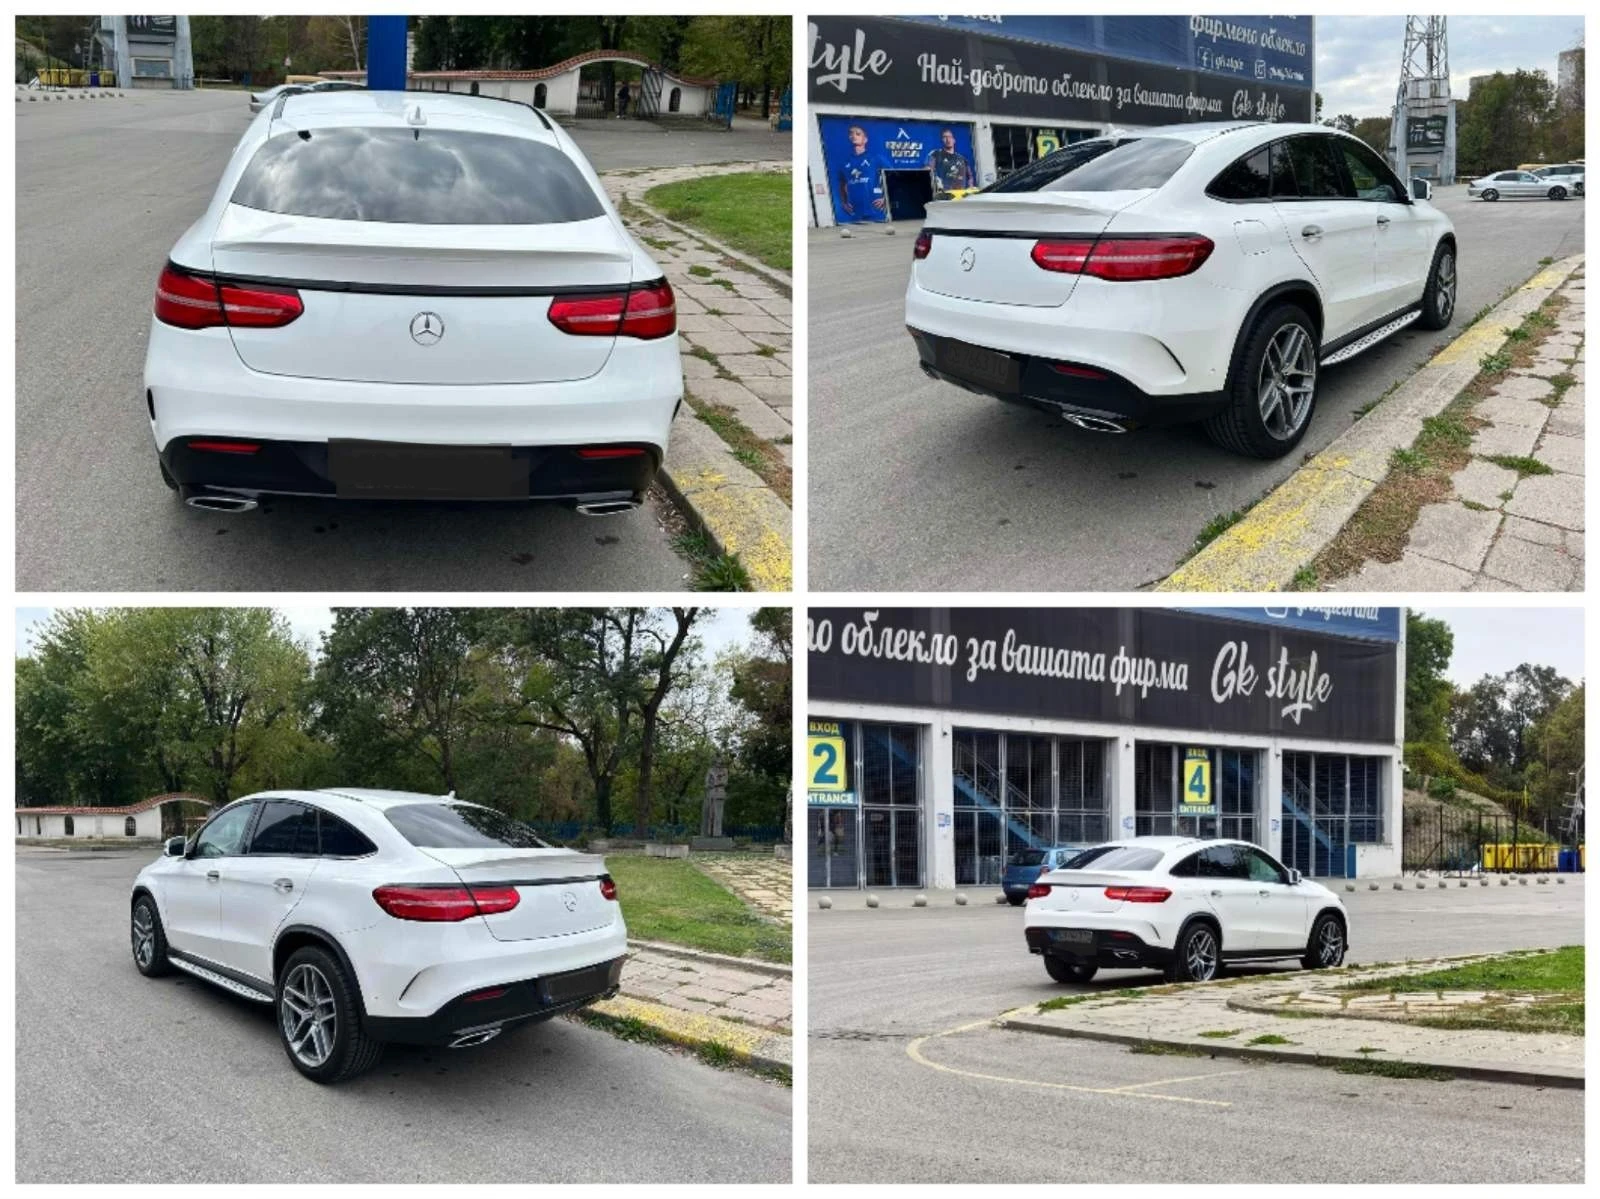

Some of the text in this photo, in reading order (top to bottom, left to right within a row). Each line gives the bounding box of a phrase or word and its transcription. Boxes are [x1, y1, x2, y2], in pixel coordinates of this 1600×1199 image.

[1190, 15, 1306, 57] фирмено облекло
[917, 53, 1222, 117] Най-доброто облекло за вашата фирма
[1232, 89, 1287, 123] Gk style
[841, 609, 957, 666] облекло
[966, 637, 997, 682] за
[1001, 628, 1106, 682] вашата
[1110, 645, 1189, 699] фирма
[1211, 641, 1334, 725] Gk style
[809, 721, 840, 735] ВХОД
[813, 742, 839, 784] 2
[1188, 764, 1206, 799] 4
